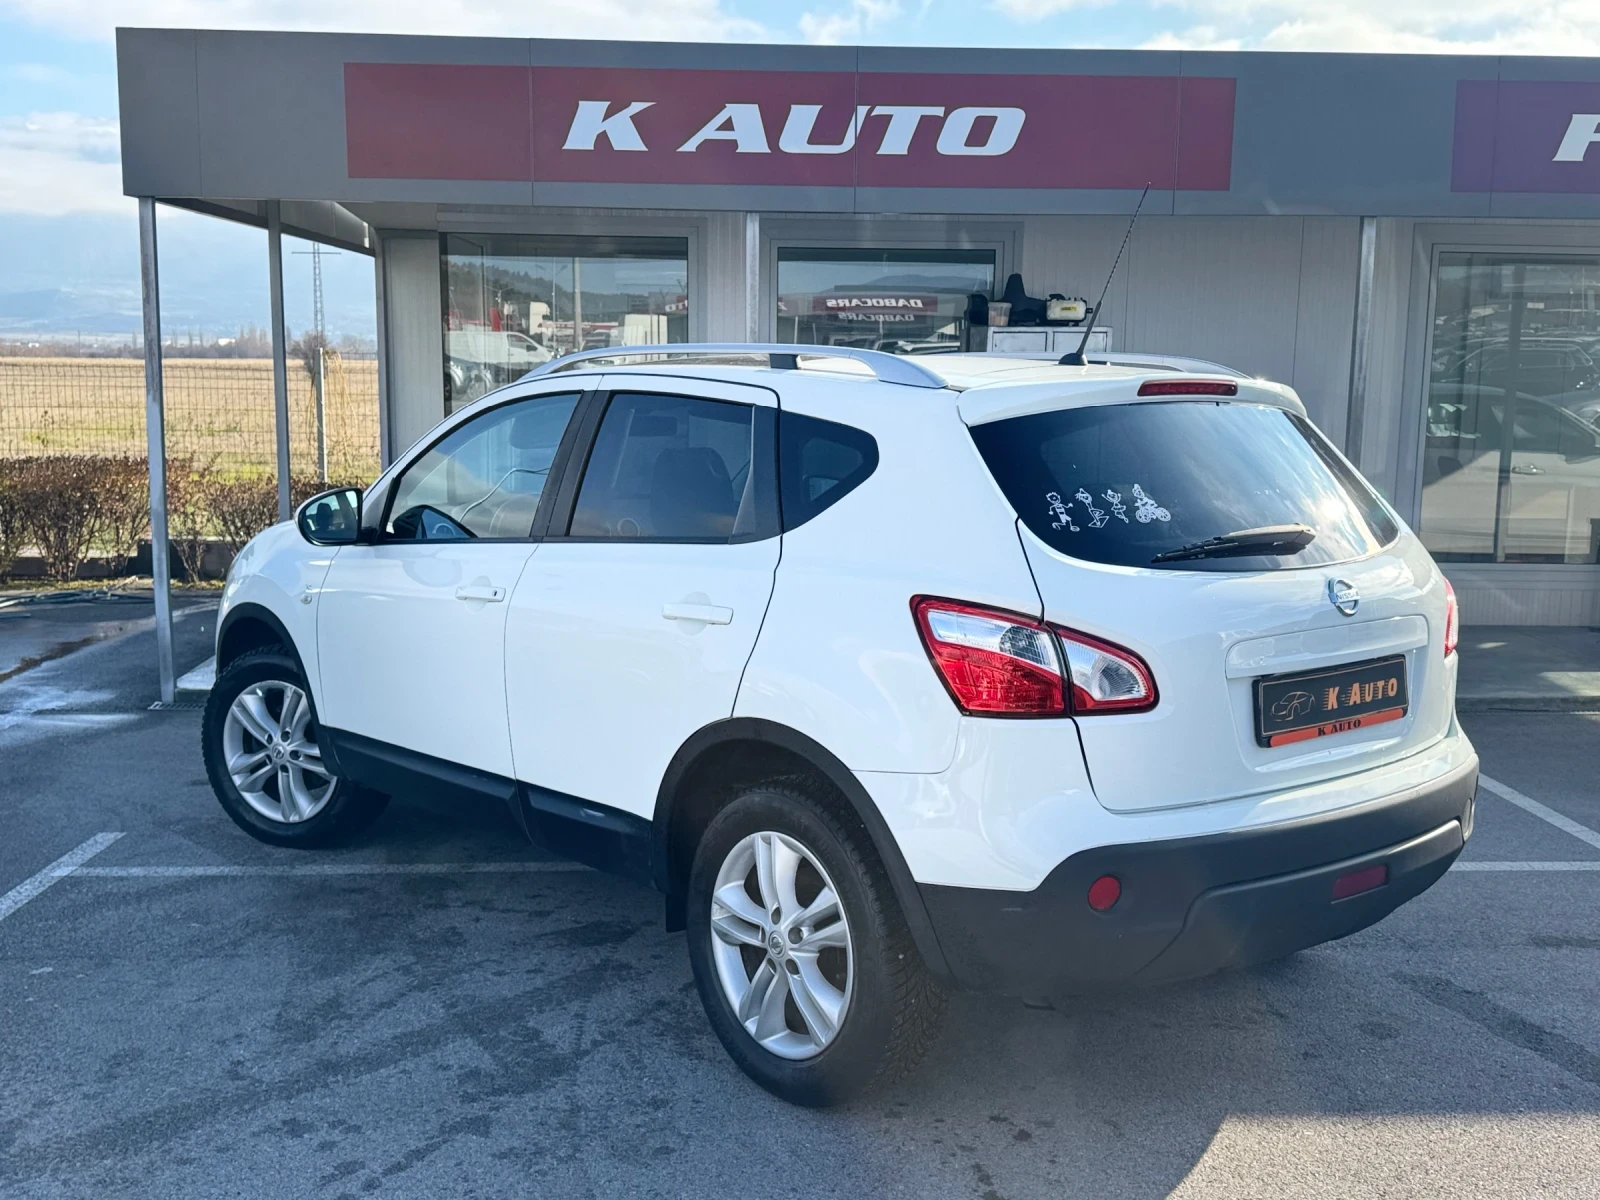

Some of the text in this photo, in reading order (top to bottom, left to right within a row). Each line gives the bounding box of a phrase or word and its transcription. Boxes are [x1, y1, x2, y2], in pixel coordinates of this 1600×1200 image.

[562, 101, 1025, 155] K AUTO
[1324, 678, 1397, 710] K AUTO
[1317, 720, 1361, 736] K AUTO
